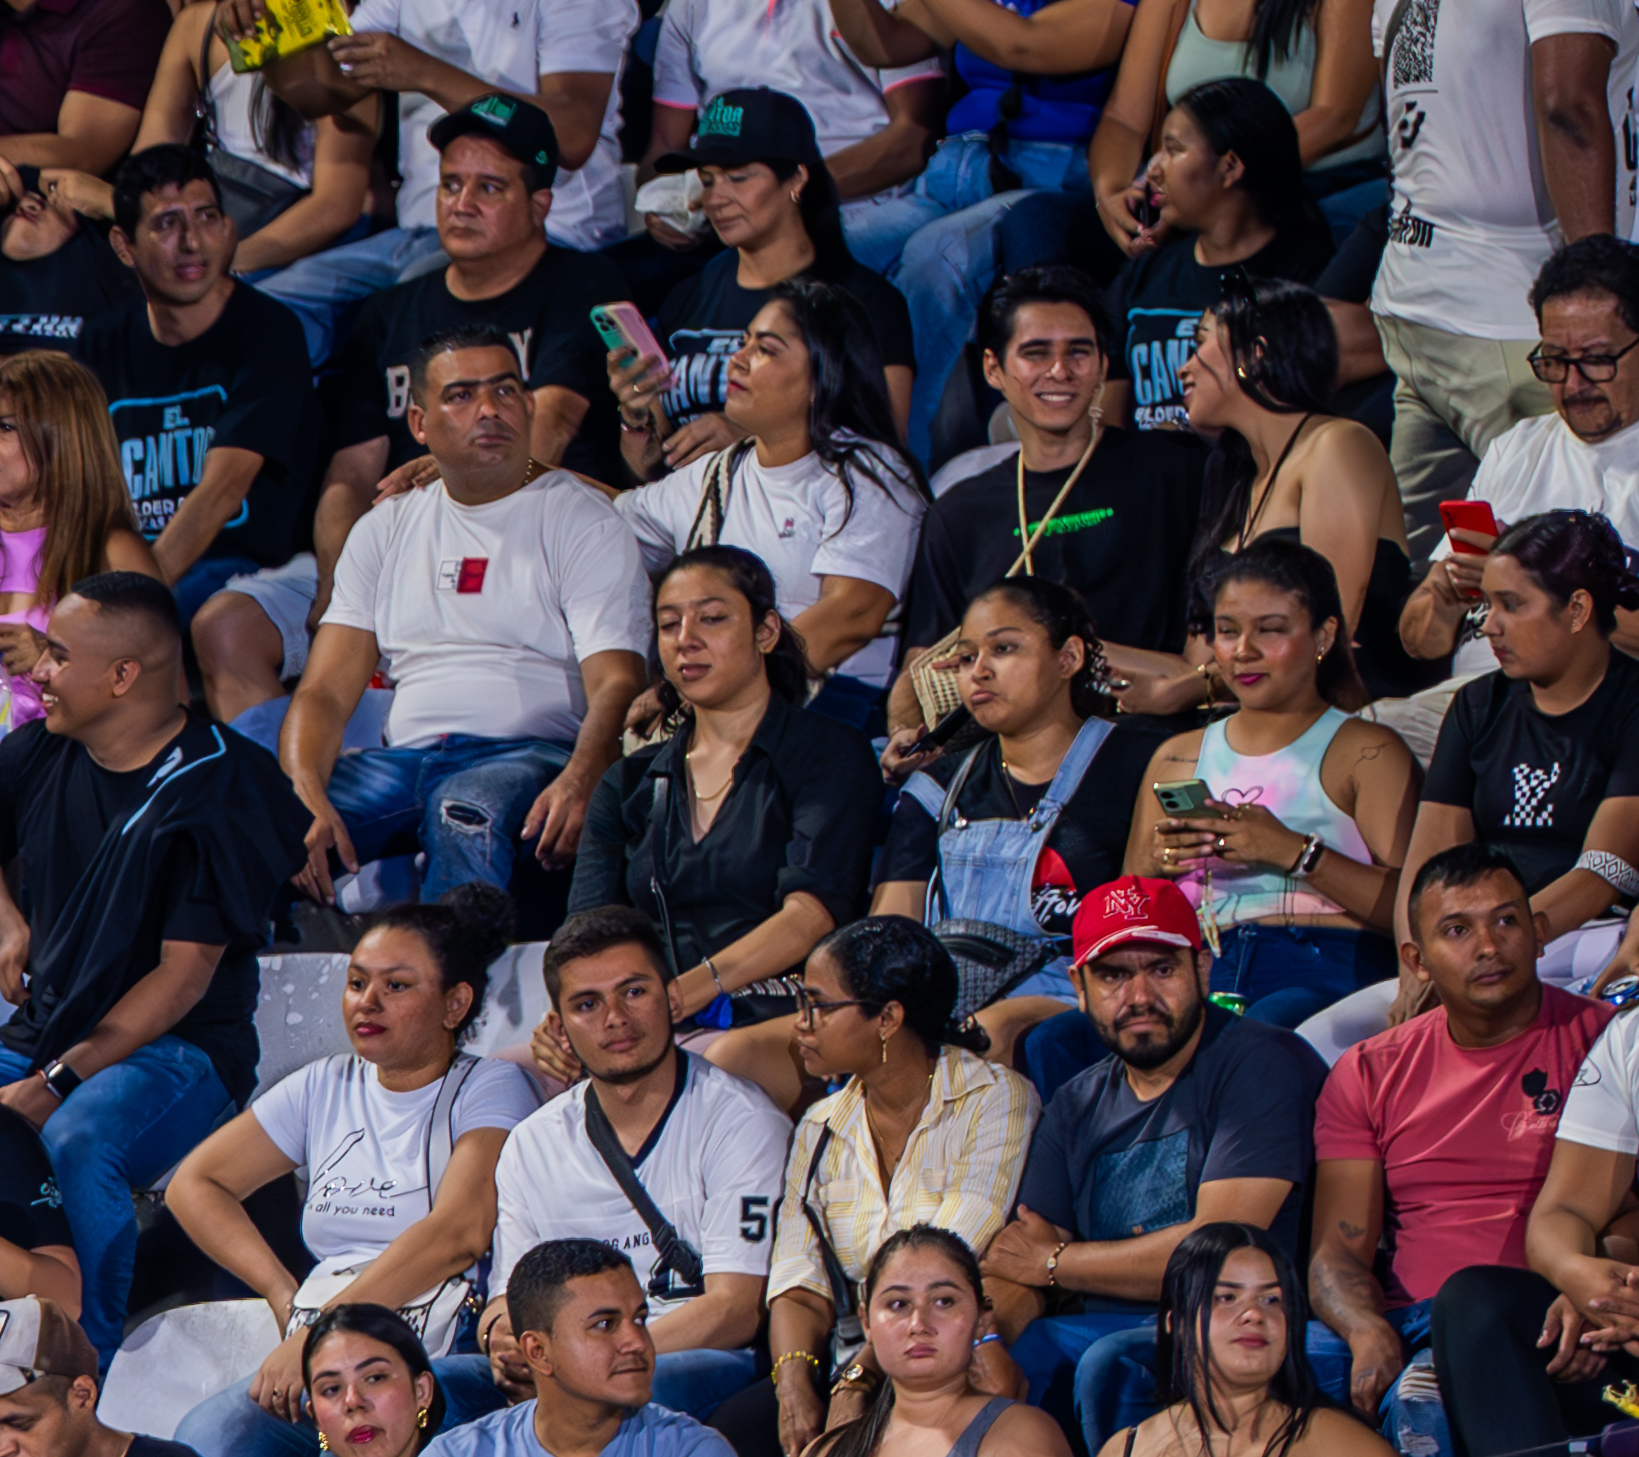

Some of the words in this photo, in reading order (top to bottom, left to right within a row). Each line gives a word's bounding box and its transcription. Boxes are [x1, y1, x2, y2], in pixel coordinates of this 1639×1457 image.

[314, 1201, 331, 1214] all
[333, 1203, 359, 1217] you
[362, 1202, 396, 1218] need
